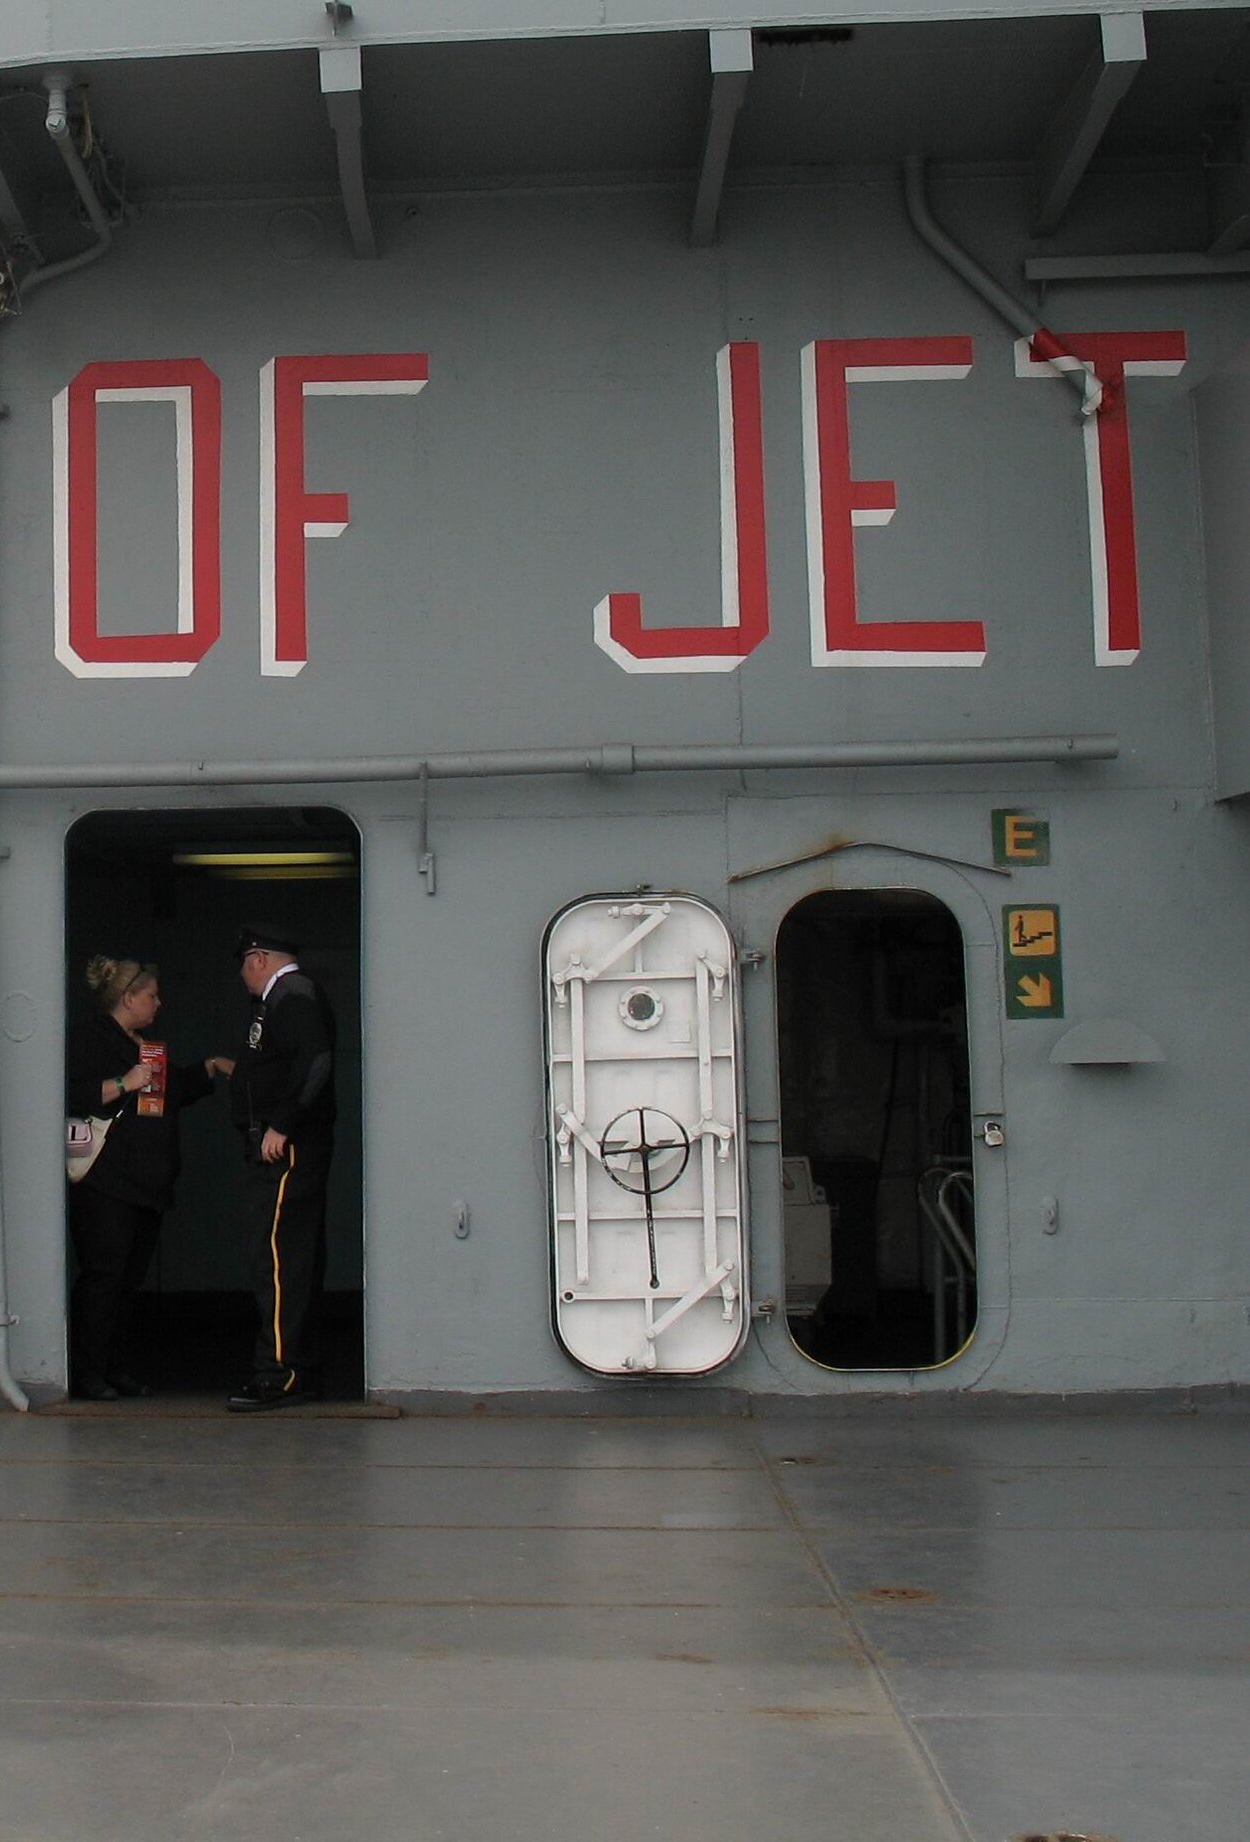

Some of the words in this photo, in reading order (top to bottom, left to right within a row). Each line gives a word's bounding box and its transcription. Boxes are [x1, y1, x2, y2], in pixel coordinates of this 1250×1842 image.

[53, 353, 429, 678] OF
[594, 330, 1186, 673] JET
[1005, 815, 1038, 857] E
